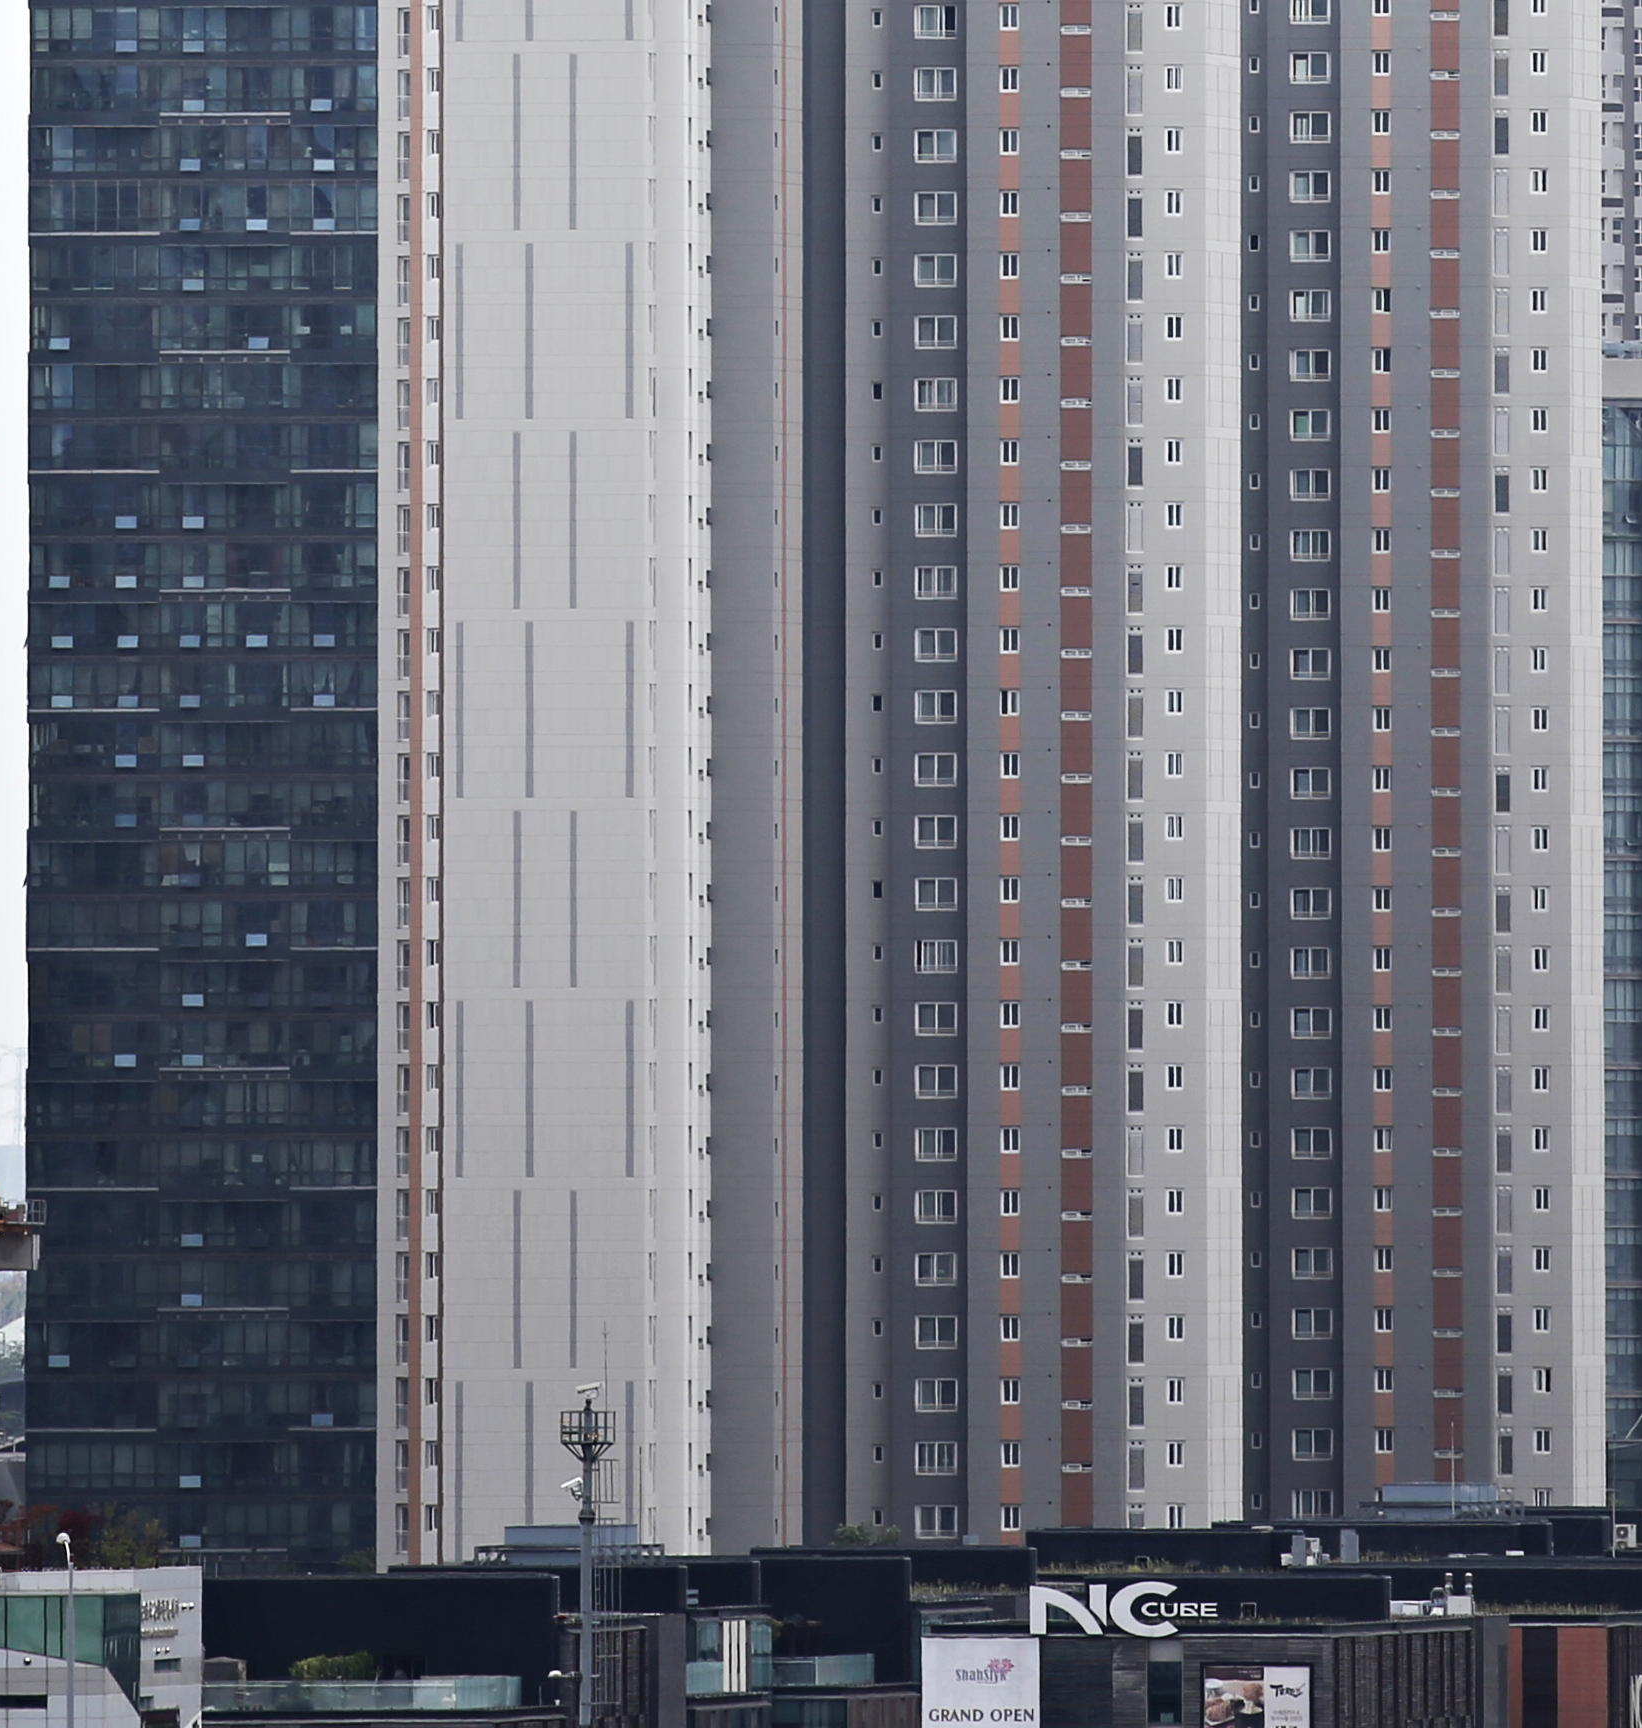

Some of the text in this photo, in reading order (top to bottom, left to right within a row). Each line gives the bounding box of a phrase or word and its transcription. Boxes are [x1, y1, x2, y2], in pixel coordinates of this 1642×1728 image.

[1141, 1602, 1218, 1617] CUBE
[929, 1708, 1034, 1722] GRAND OPEN
